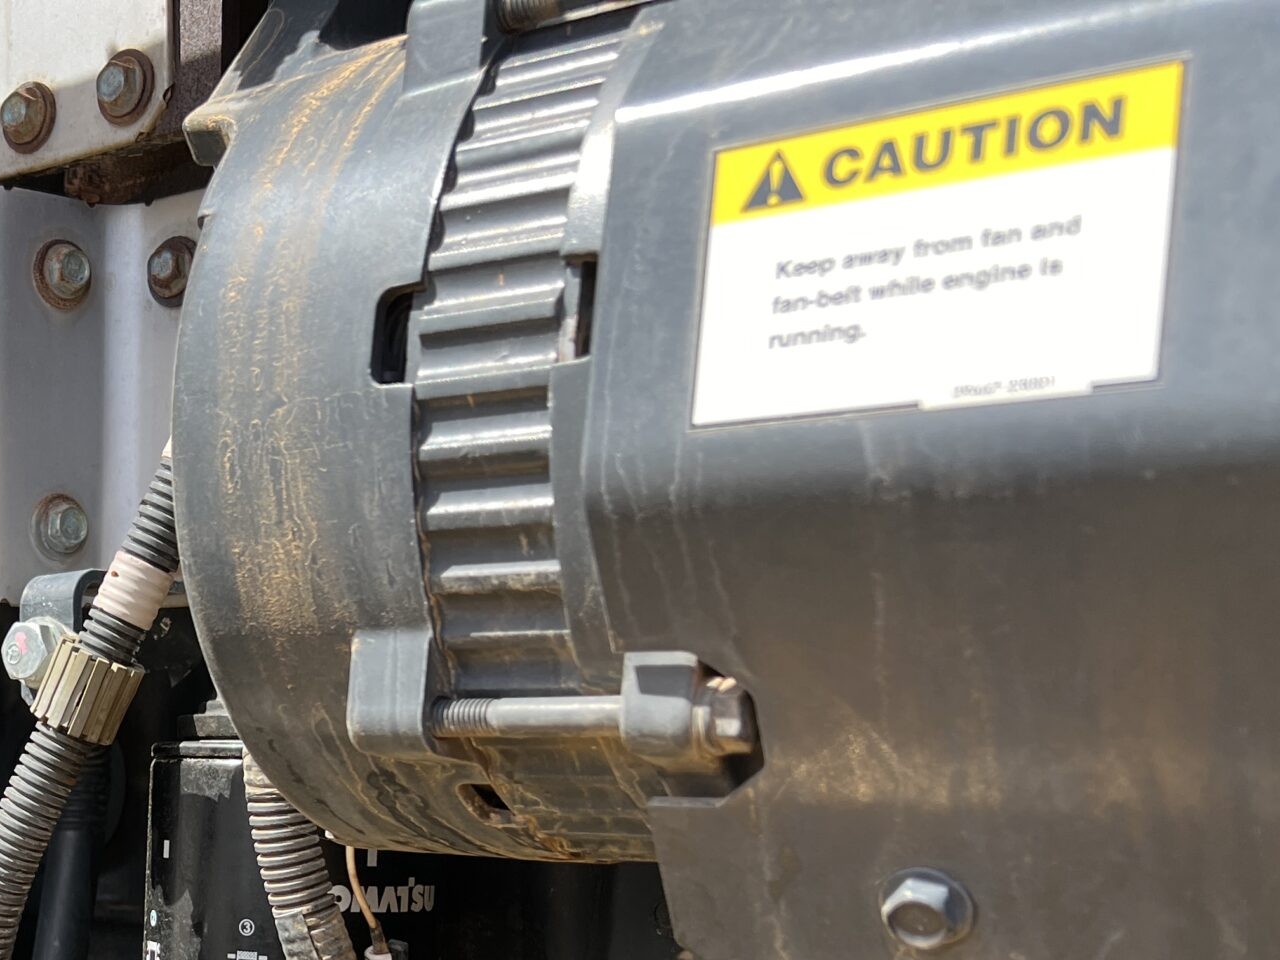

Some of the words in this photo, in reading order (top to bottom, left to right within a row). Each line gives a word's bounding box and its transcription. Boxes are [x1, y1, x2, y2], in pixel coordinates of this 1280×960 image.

[822, 96, 1126, 189] CAUTION
[775, 257, 836, 279] Keep
[841, 246, 906, 268] away
[912, 235, 973, 258] from
[980, 227, 1022, 247] fan
[1030, 215, 1082, 241] and
[772, 285, 862, 314] fan-belt
[868, 276, 935, 300] while
[941, 263, 1033, 290] engine
[1039, 256, 1063, 276] is
[768, 324, 867, 349] running.
[327, 877, 436, 913] OMATSU
